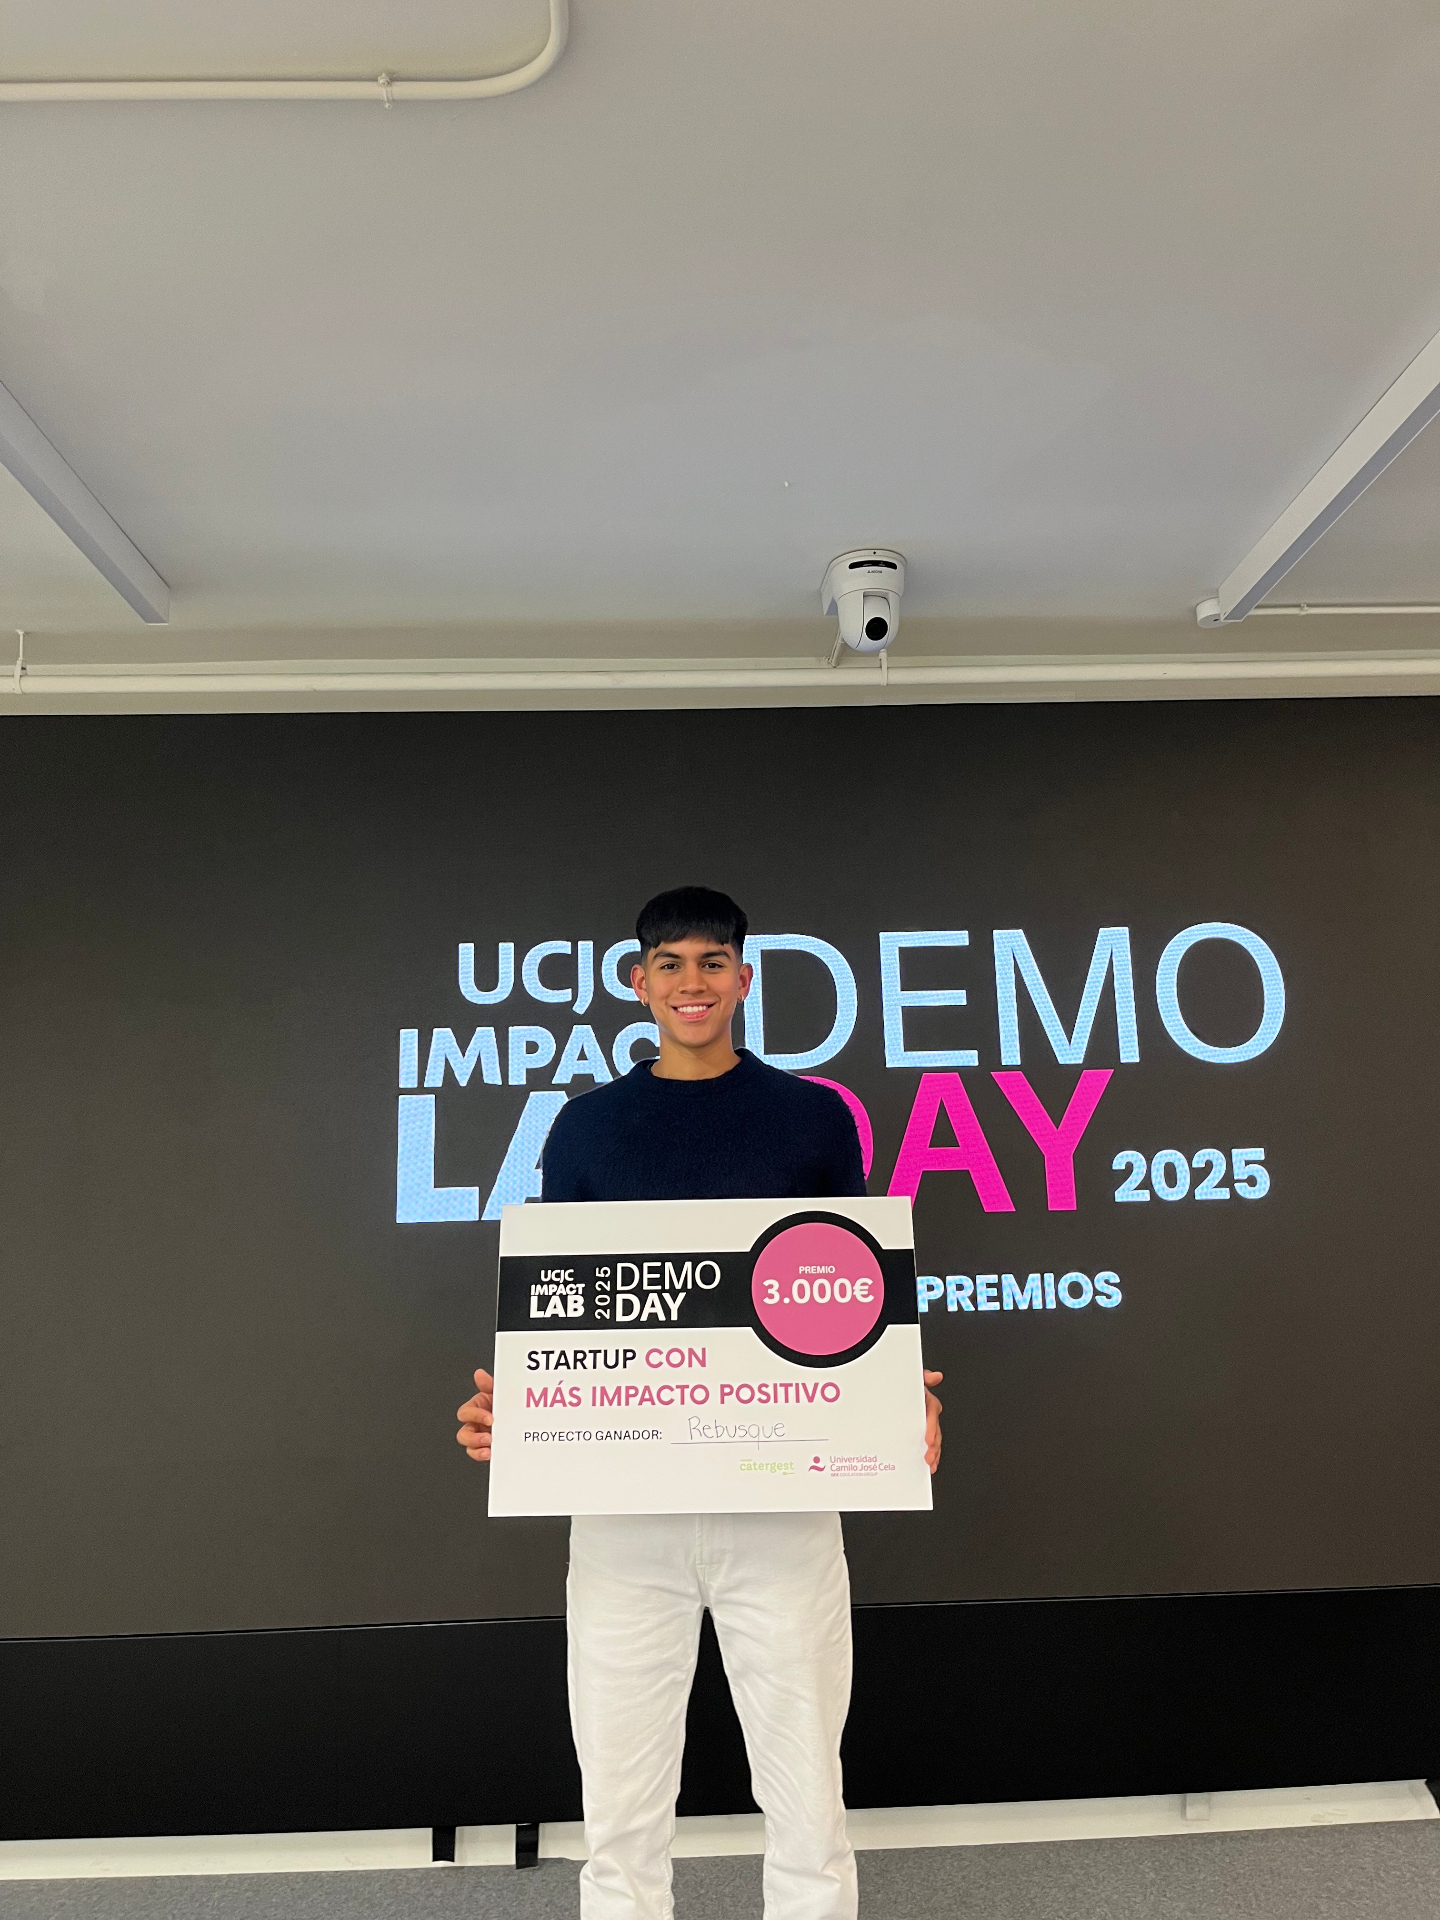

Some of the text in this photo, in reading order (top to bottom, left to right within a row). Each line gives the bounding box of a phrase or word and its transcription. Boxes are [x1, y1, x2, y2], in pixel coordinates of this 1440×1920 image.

[743, 921, 1286, 1070] DEMO
[399, 1021, 661, 1088] IMPAC
[396, 1090, 570, 1224] LA
[1111, 1147, 1271, 1203] 2025
[540, 1269, 575, 1284] UCJC
[616, 1260, 722, 1291] DEMO
[798, 1265, 836, 1275] PREMIO
[530, 1283, 586, 1296] IMPACT
[595, 1266, 611, 1320] 2025
[762, 1277, 875, 1305] 3.000€
[916, 1270, 1123, 1313] PREMIOS
[529, 1295, 585, 1319] LAB
[615, 1291, 687, 1322] DAY
[526, 1347, 707, 1371] STARTUP CON
[525, 1380, 841, 1408] MÁS IMPACTO POSITIVO
[523, 1430, 663, 1442] PROYECTO GANADOR:
[687, 1415, 787, 1450] Rebusque
[739, 1460, 795, 1473] catergest
[829, 1455, 878, 1463] Universidad
[830, 1462, 896, 1472] Camilo José Cela
